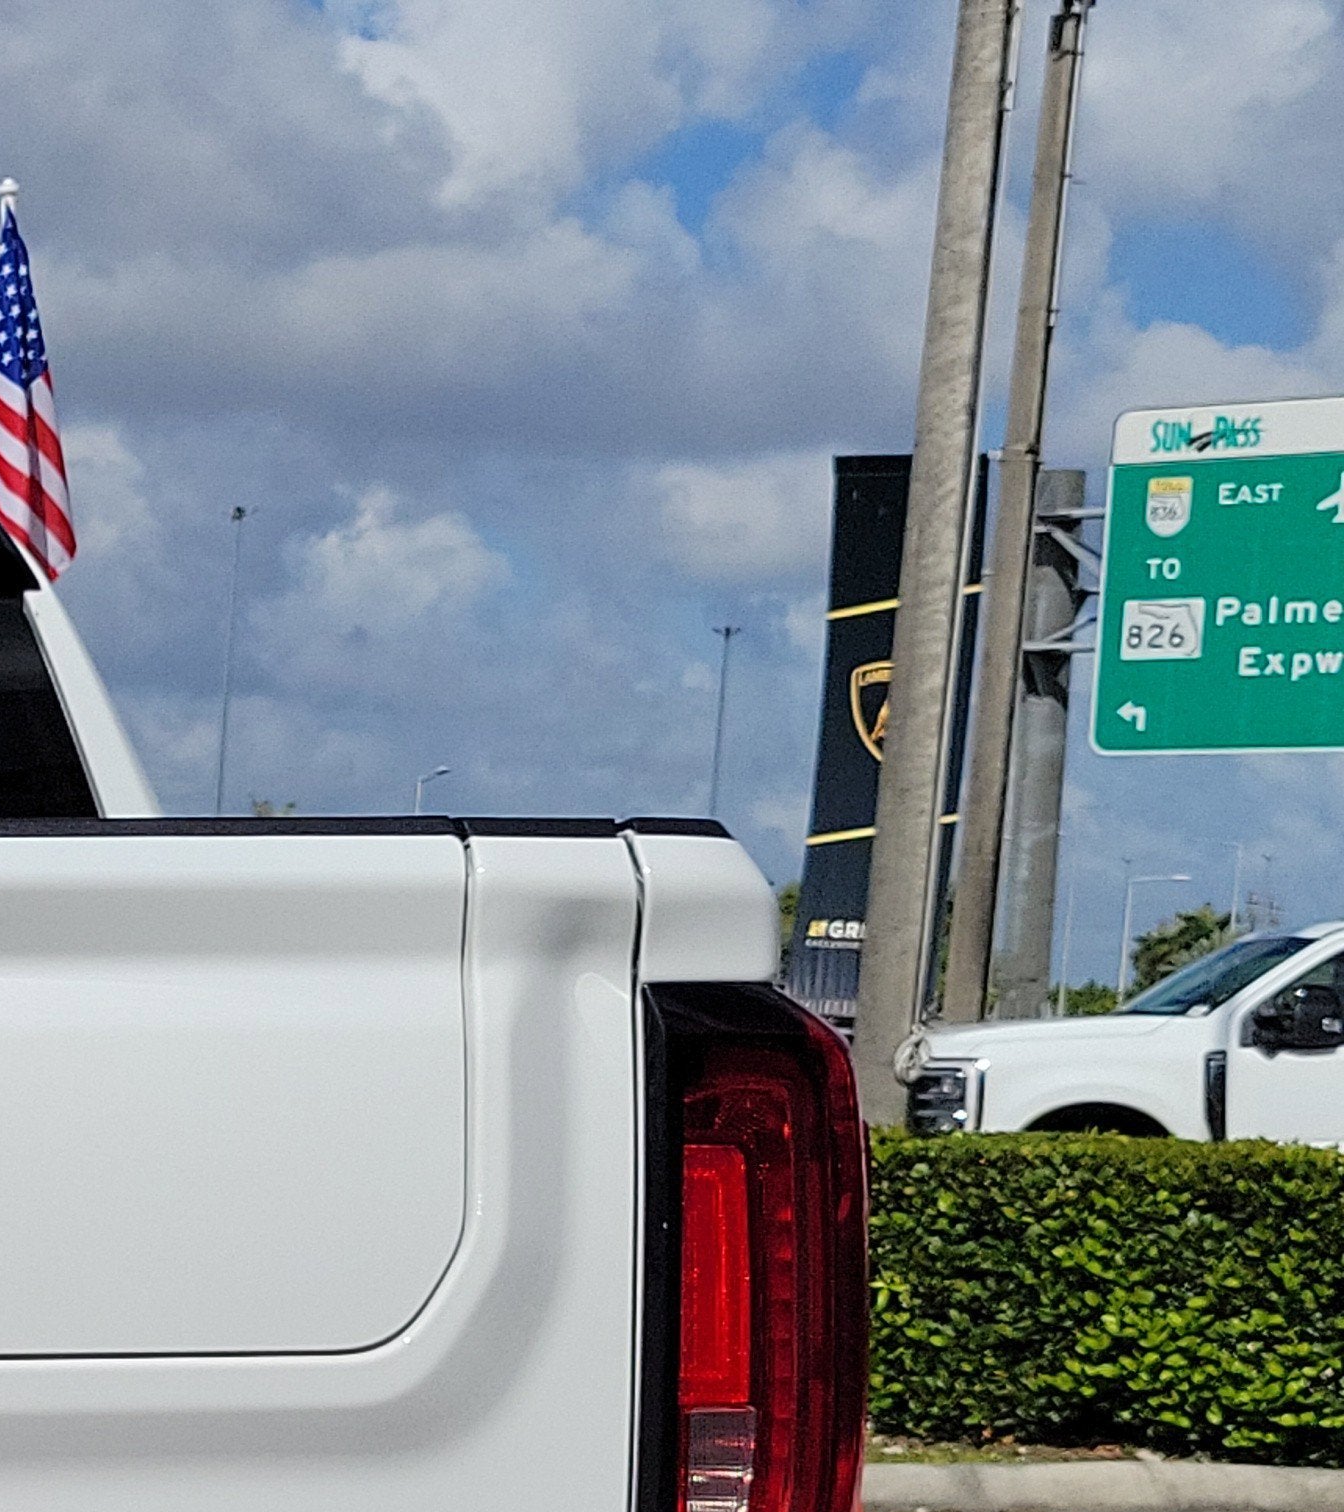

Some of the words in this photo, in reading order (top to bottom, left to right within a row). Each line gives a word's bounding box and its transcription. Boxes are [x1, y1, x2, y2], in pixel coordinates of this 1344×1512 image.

[1218, 483, 1284, 505] EAST
[1145, 558, 1181, 579] TO
[1216, 594, 1343, 626] Palme
[1126, 623, 1185, 649] 826
[1238, 646, 1343, 682] Expw
